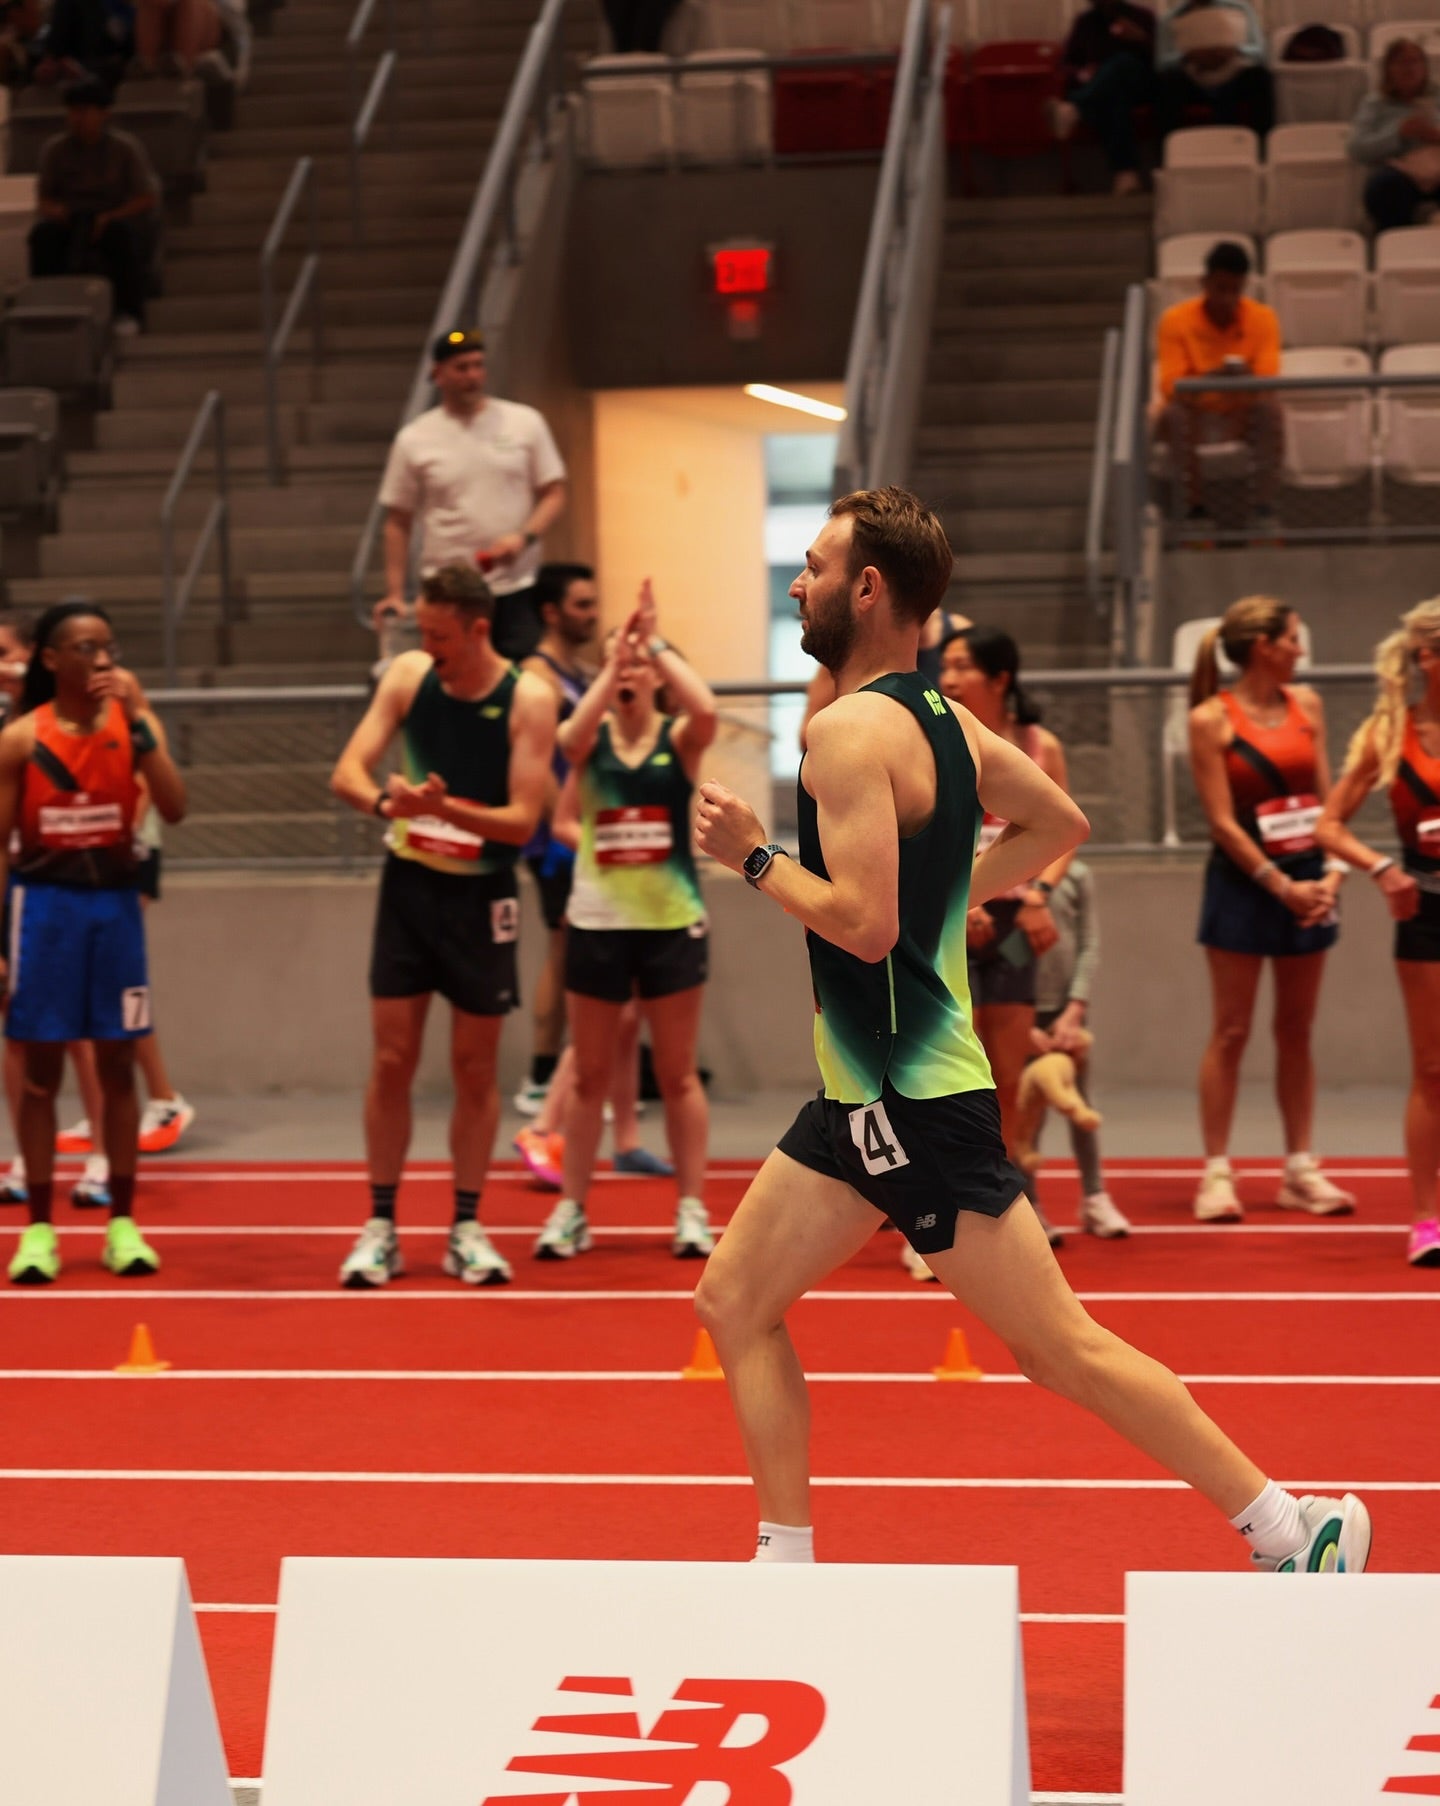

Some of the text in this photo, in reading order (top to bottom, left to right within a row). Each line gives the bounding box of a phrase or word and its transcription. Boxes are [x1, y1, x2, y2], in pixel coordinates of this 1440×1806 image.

[130, 991, 144, 1026] 7
[864, 1109, 897, 1166] 4
[914, 1213, 937, 1230] NB
[478, 1676, 827, 1806] NB
